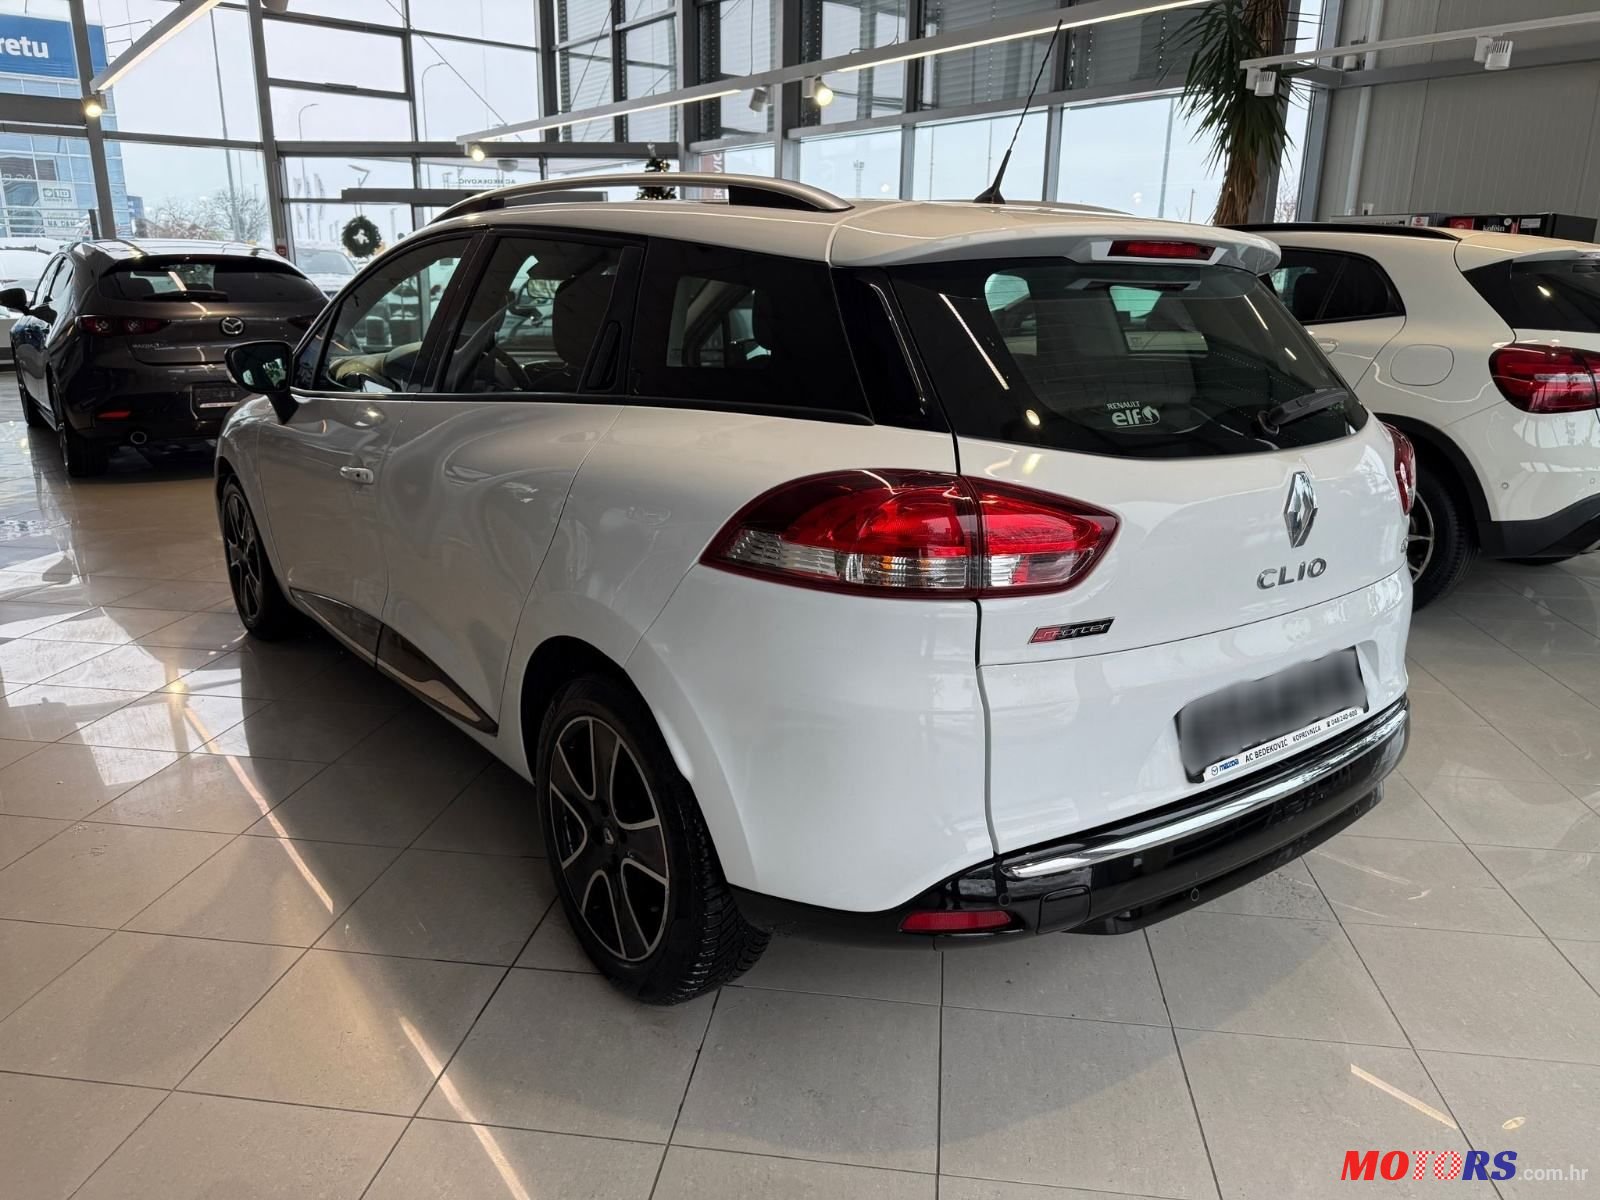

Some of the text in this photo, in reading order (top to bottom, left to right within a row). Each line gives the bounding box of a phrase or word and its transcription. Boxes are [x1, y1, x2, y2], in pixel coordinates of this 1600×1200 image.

[1107, 400, 1140, 410] RENAULT
[1111, 408, 1141, 426] elf
[1256, 557, 1327, 590] CLIO
[1245, 752, 1254, 763] AC
[1254, 737, 1288, 759] BEDEKOVIĆ
[1292, 725, 1321, 742] KOPRIVNICA
